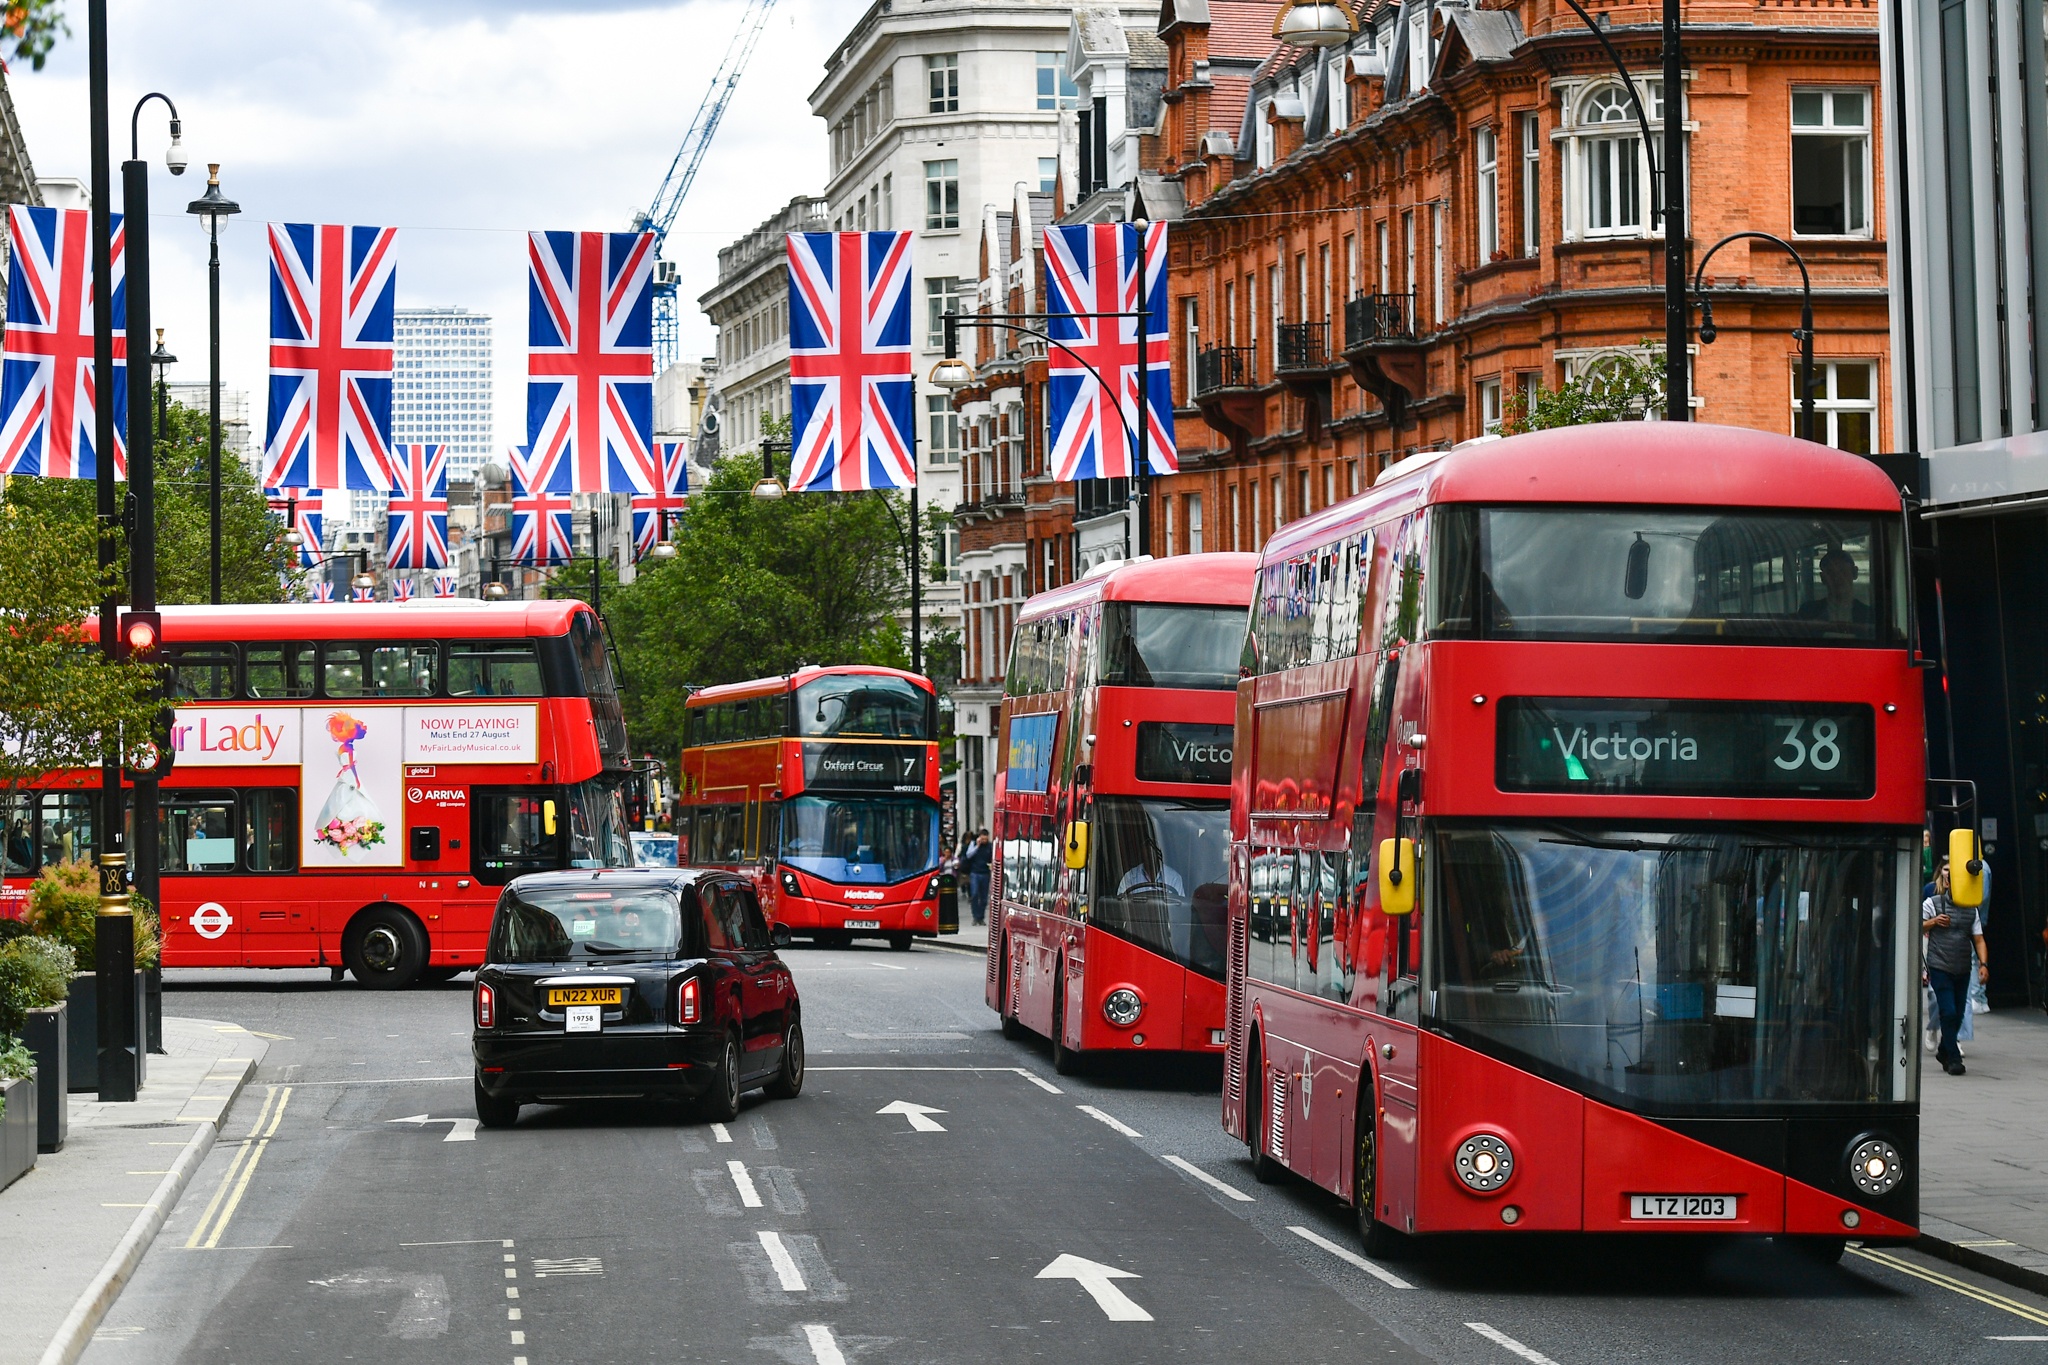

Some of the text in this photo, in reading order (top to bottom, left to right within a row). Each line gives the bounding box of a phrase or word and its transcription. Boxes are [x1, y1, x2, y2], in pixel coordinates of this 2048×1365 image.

[420, 718, 520, 730] NOW PLAYING!
[200, 713, 285, 761] Lady
[430, 731, 510, 740] Must End 27 August
[420, 744, 521, 753] MyFairLadyMusical.co.uk
[1553, 718, 1841, 771] Victoria 38
[1172, 741, 1233, 763] Victo
[411, 767, 430, 776] global
[823, 758, 916, 777] Oxford Circus 7
[424, 790, 466, 800] ARRIVA
[843, 889, 885, 900] Metroline
[554, 989, 615, 1002] LN22 XUR
[1642, 1198, 1725, 1216] LTZ 1203
